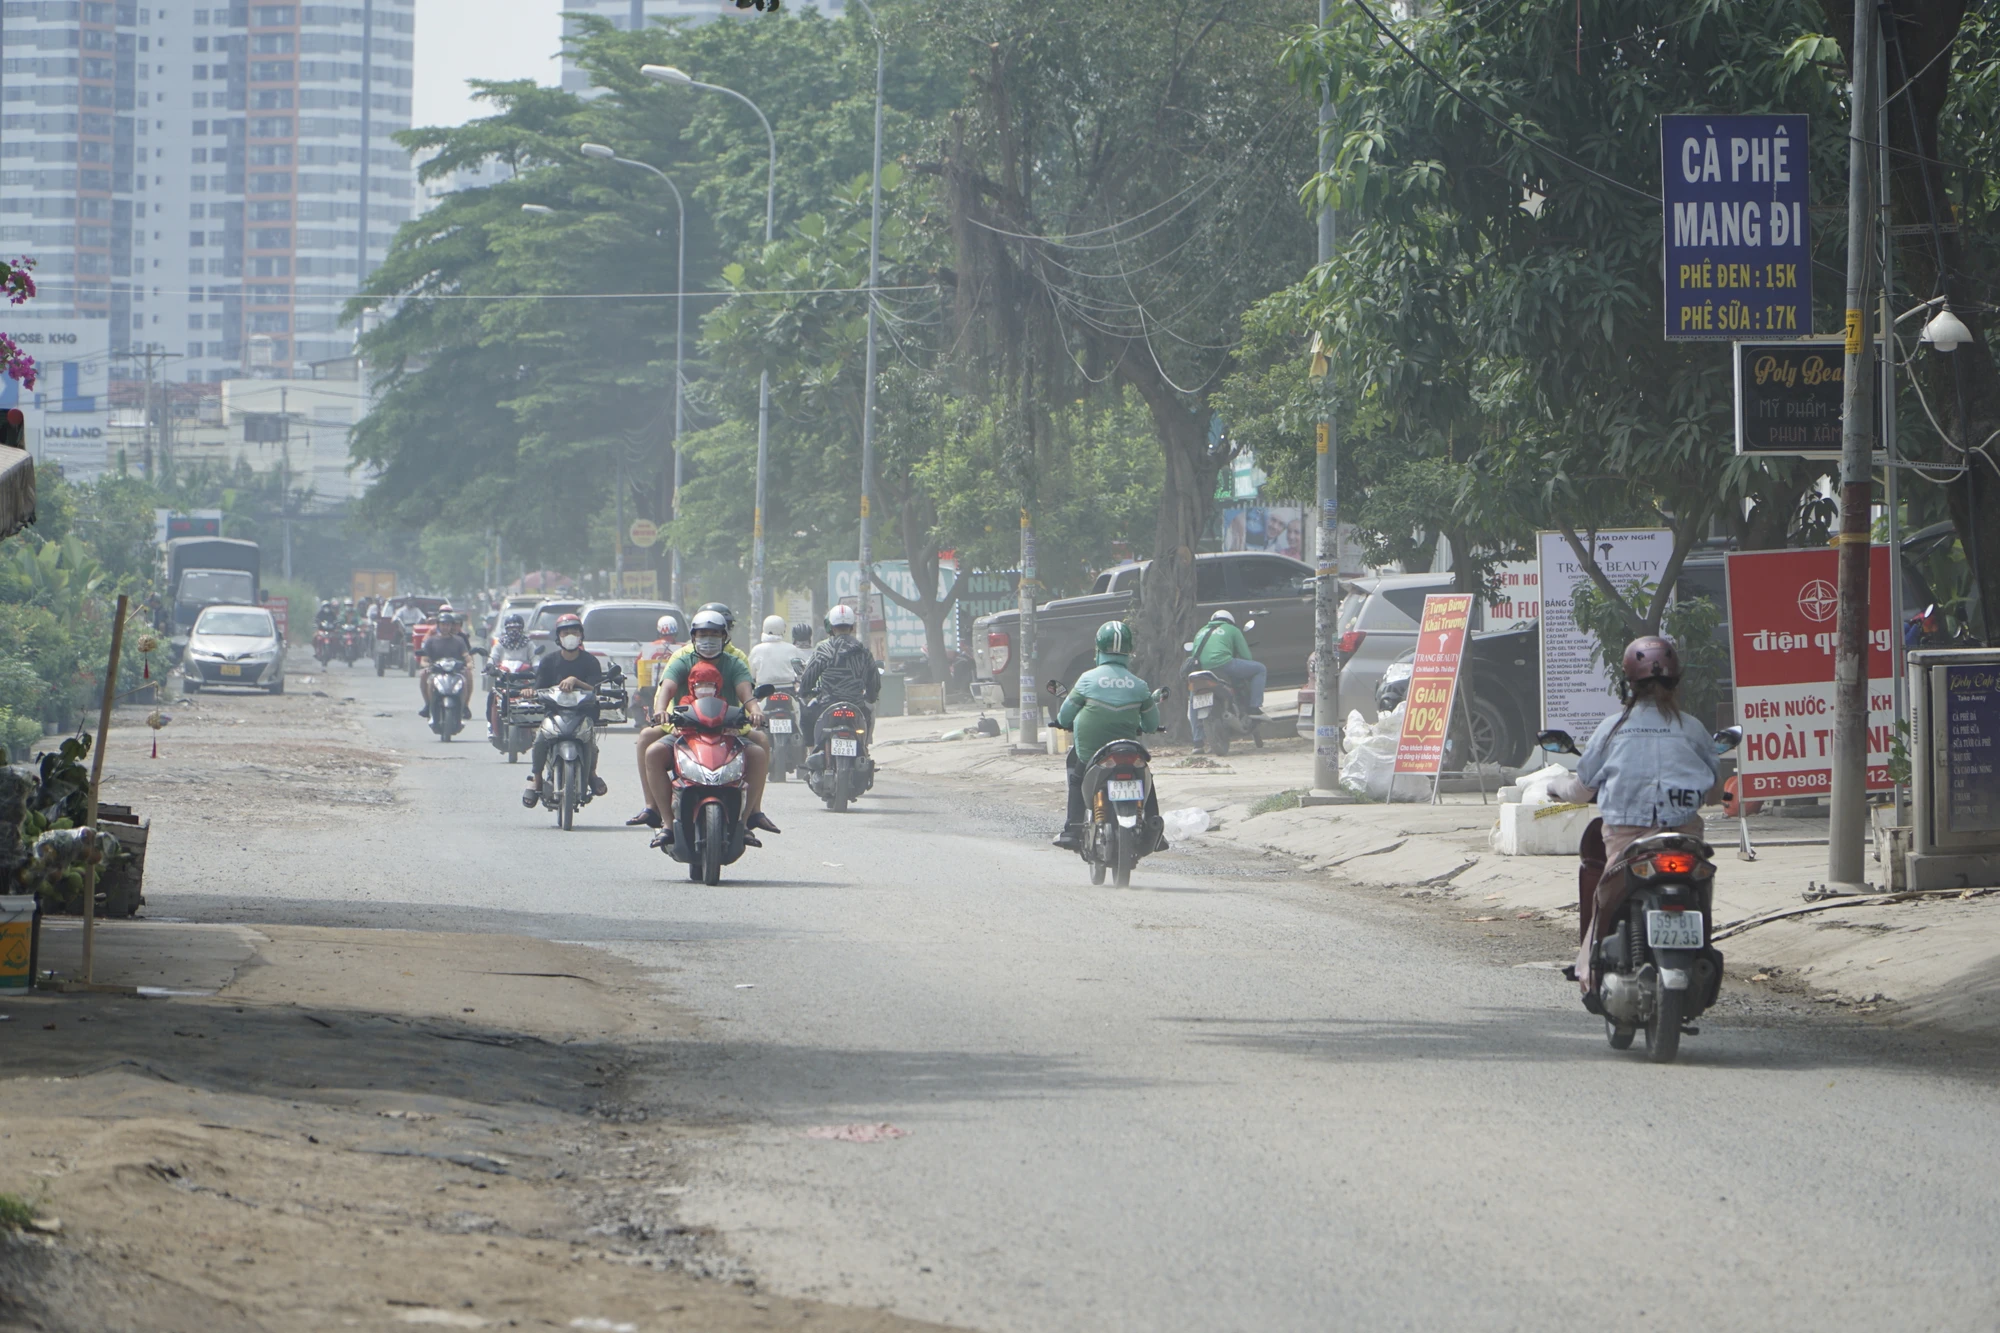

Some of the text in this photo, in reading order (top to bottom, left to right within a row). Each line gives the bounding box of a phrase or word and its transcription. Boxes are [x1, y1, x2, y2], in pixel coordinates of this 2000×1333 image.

[1682, 125, 1791, 183] CÀ PHÊ
[1674, 201, 1800, 247] MANG ĐI
[1680, 258, 1712, 289] PHÊ
[1717, 264, 1750, 288] ĐEN
[1766, 264, 1797, 288] 15K
[1681, 299, 1712, 330] PHÊ
[1718, 299, 1750, 330] SỮA
[1766, 305, 1797, 330] 17K
[1755, 355, 1845, 388] Poly Bea
[1759, 398, 1779, 418] MỸ
[1787, 393, 1826, 418] PHẨM
[1770, 427, 1807, 442] PHUN
[1557, 561, 1660, 573] TRAG BEAUTY
[1545, 599, 1567, 607] BẢNG
[1743, 629, 1808, 653] điện
[1417, 653, 1460, 661] TRANG BEAUTY
[1098, 676, 1135, 689] Grab
[1415, 682, 1446, 703] GIẢM
[1745, 698, 1780, 723] ĐIỆN
[1785, 695, 1826, 716] NƯỚC
[1971, 694, 1987, 703] Away
[1409, 707, 1443, 732] 10%
[1747, 724, 1806, 761] HOÀI
[1753, 777, 1781, 790] ĐT:
[1867, 770, 1895, 783] 12
[1657, 913, 1694, 929] 59-B1
[1653, 930, 1699, 945] 727.35
